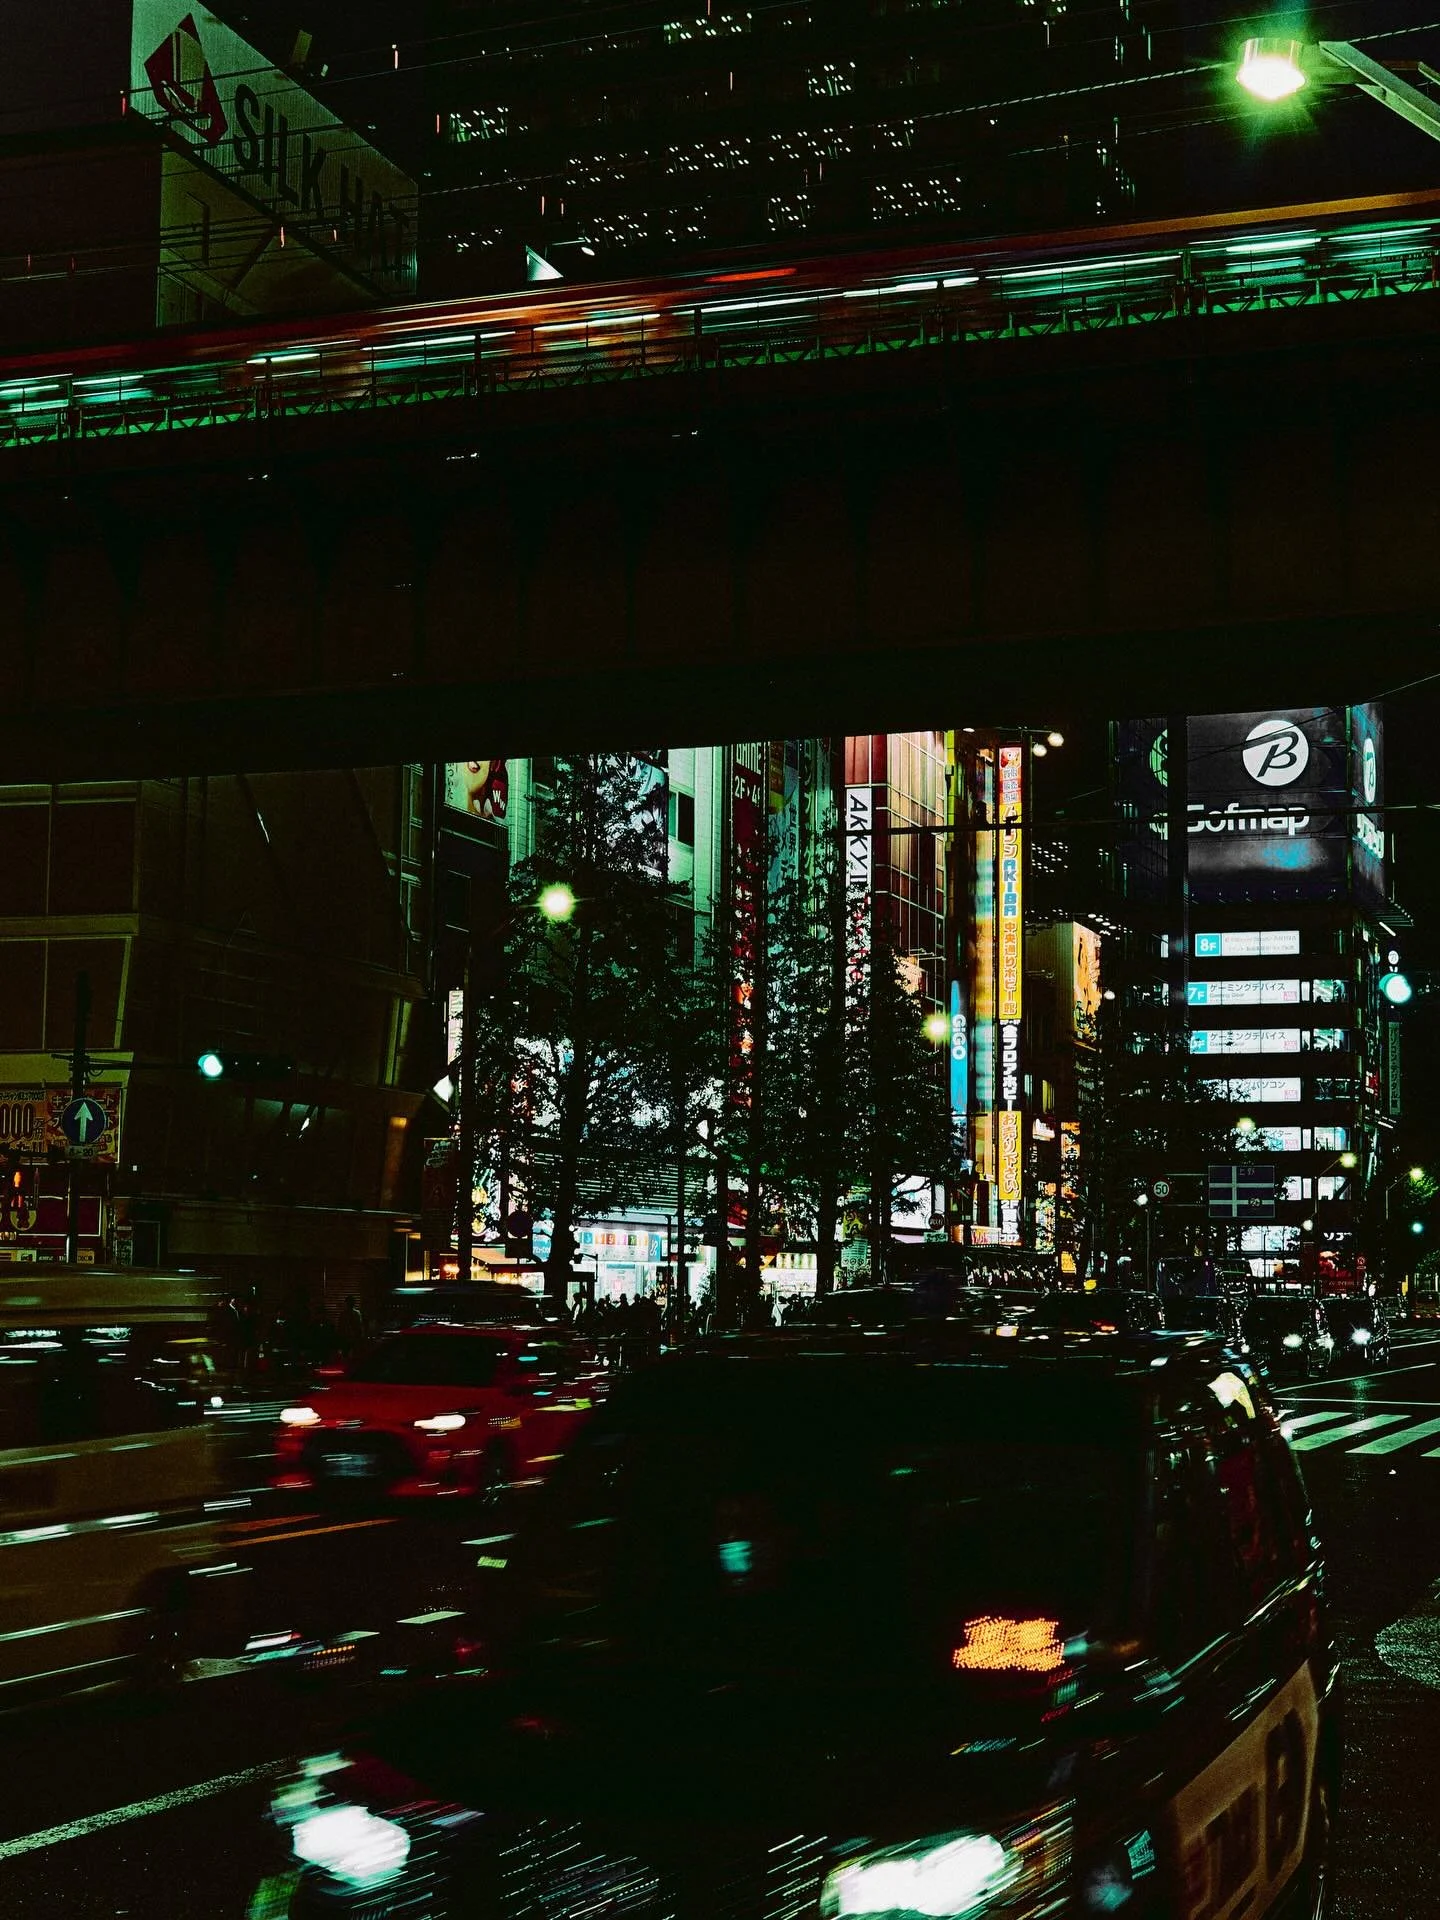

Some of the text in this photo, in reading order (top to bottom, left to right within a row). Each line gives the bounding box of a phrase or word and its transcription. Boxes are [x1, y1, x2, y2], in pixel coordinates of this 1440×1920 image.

[234, 84, 327, 219] SILK
[1187, 802, 1310, 836] Sofmap
[850, 795, 868, 871] AKKY
[1200, 938, 1216, 951] 8F
[1188, 987, 1206, 1000] 7F
[1155, 1184, 1169, 1195] 50
